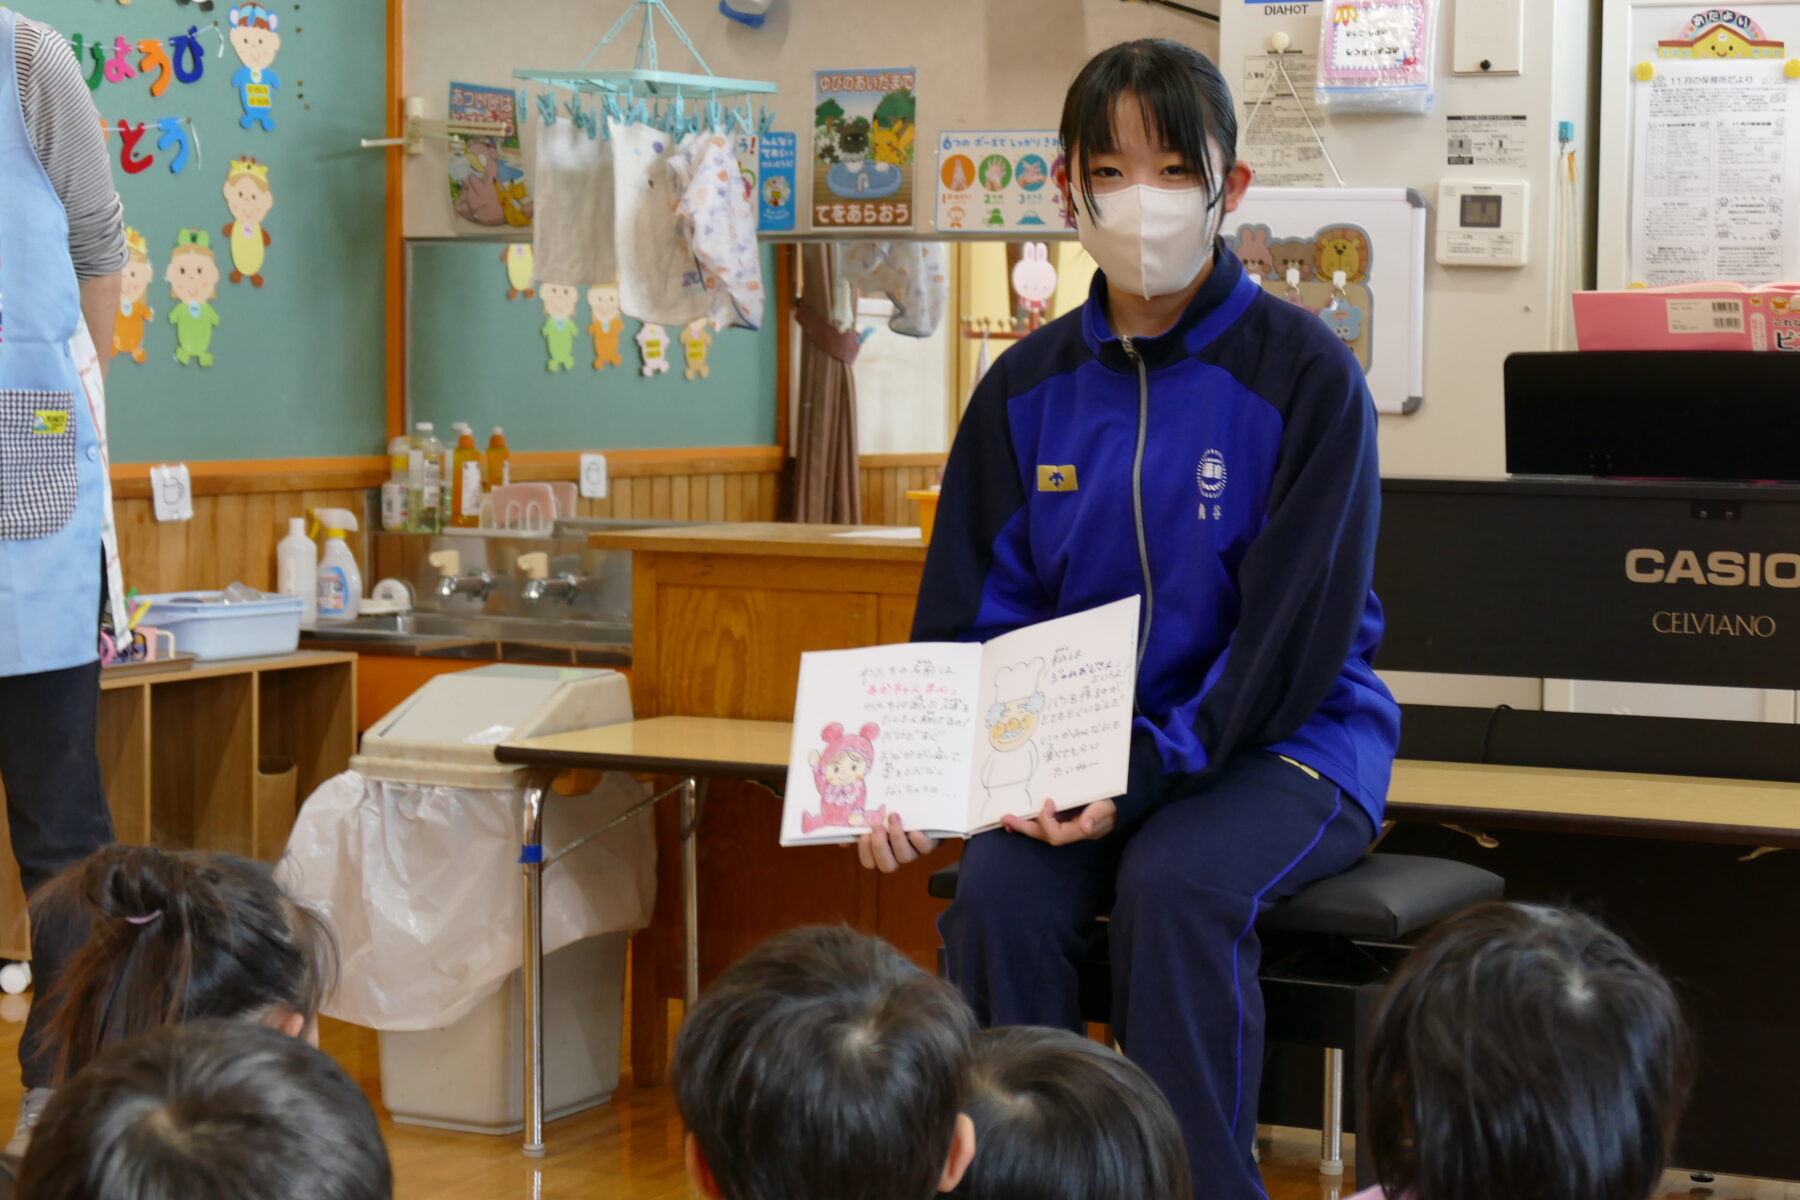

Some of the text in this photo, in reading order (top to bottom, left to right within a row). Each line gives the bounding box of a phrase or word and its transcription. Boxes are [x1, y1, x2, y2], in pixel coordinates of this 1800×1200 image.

[1264, 5, 1309, 16] DIAHOT
[1692, 9, 1751, 28] おたより
[819, 73, 914, 92] ゆびのあいだまで
[815, 203, 909, 224] てをあらおう
[1625, 548, 1800, 589] CASIO
[1652, 611, 1777, 638] CELVIANO
